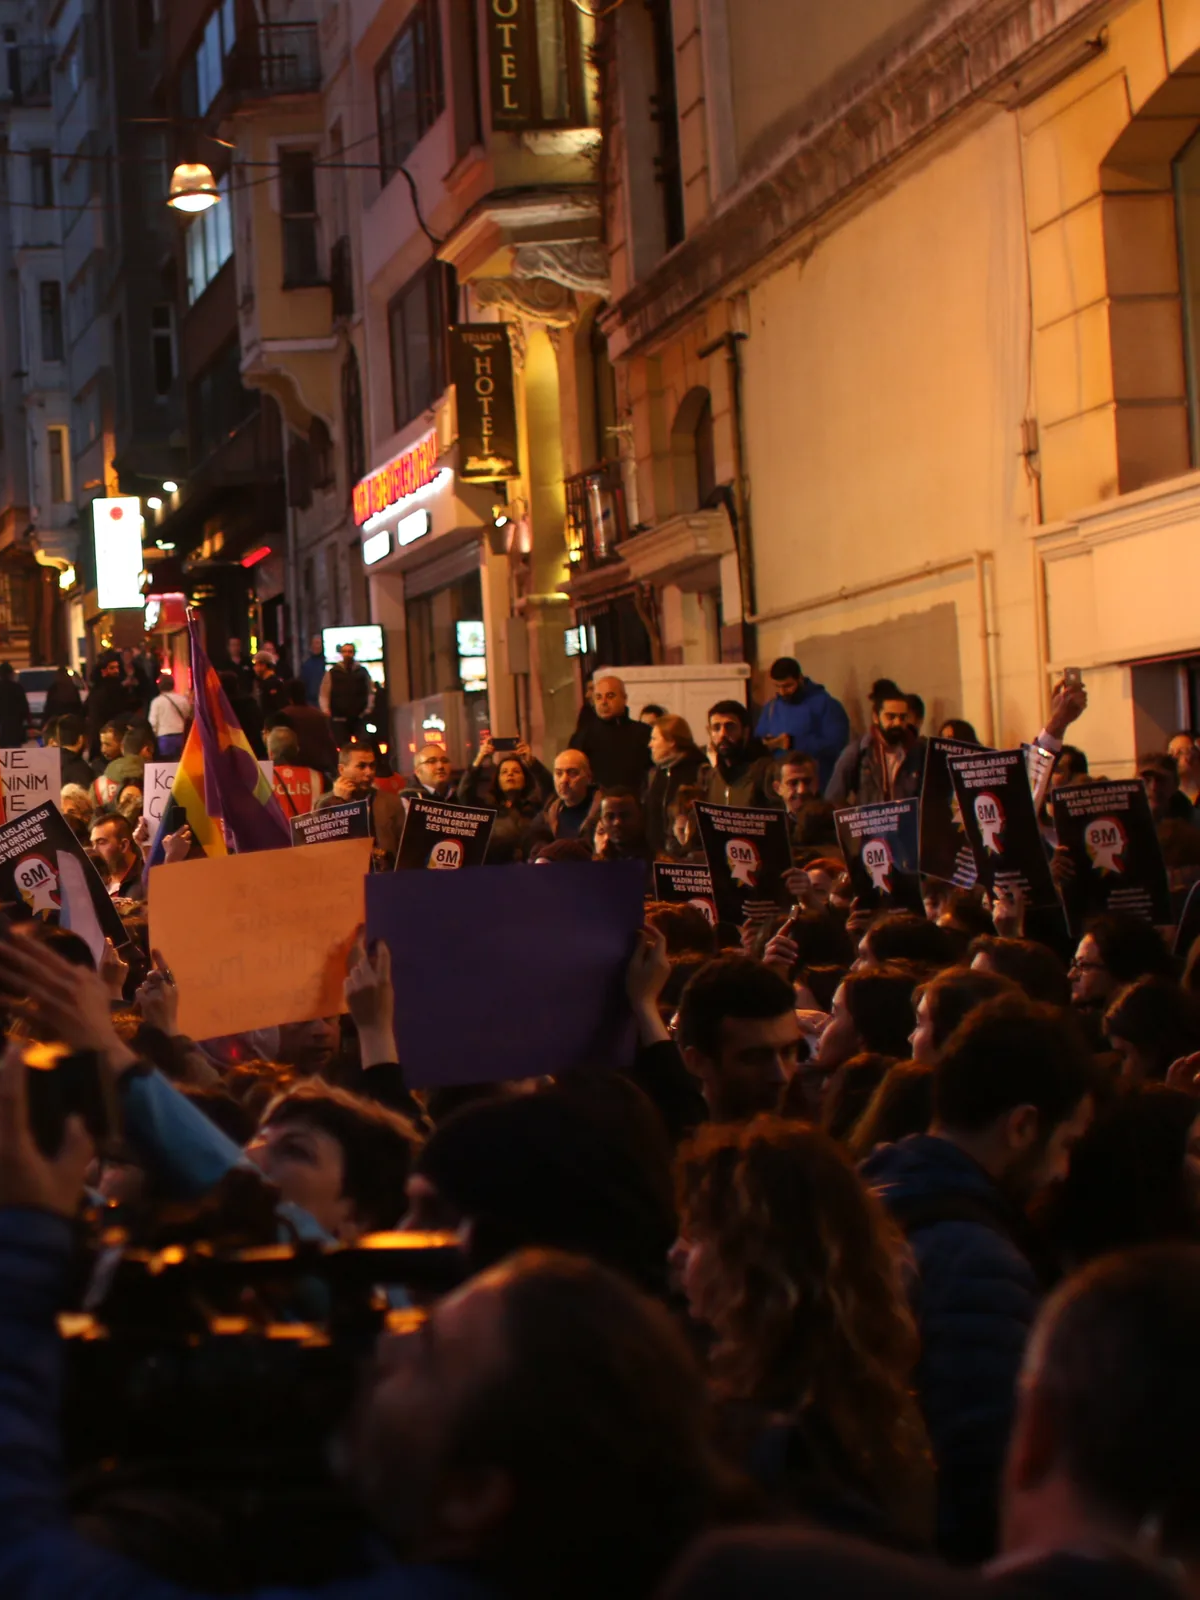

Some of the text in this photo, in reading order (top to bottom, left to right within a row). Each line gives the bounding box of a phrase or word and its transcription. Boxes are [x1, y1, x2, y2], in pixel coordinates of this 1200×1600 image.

[474, 356, 495, 456] HOTEL
[298, 818, 313, 828] MART
[312, 807, 360, 824] ULUSLARARASI
[420, 805, 443, 815] MART
[443, 810, 490, 822] ULUSLARARASI
[426, 815, 450, 825] KADIN
[977, 804, 996, 820] 8M
[304, 825, 321, 836] KADIN
[305, 826, 349, 844] SES VERİYORUZ
[425, 823, 476, 837] SES VERİYORUZ
[1091, 827, 1117, 845] 8M
[6, 832, 48, 860] VERİYORUZ
[730, 847, 751, 859] 8M
[436, 849, 458, 864] 8M
[866, 849, 885, 865] 8M
[21, 864, 48, 888] 8M
[665, 868, 684, 876] MART
[671, 876, 692, 884] KADIN
